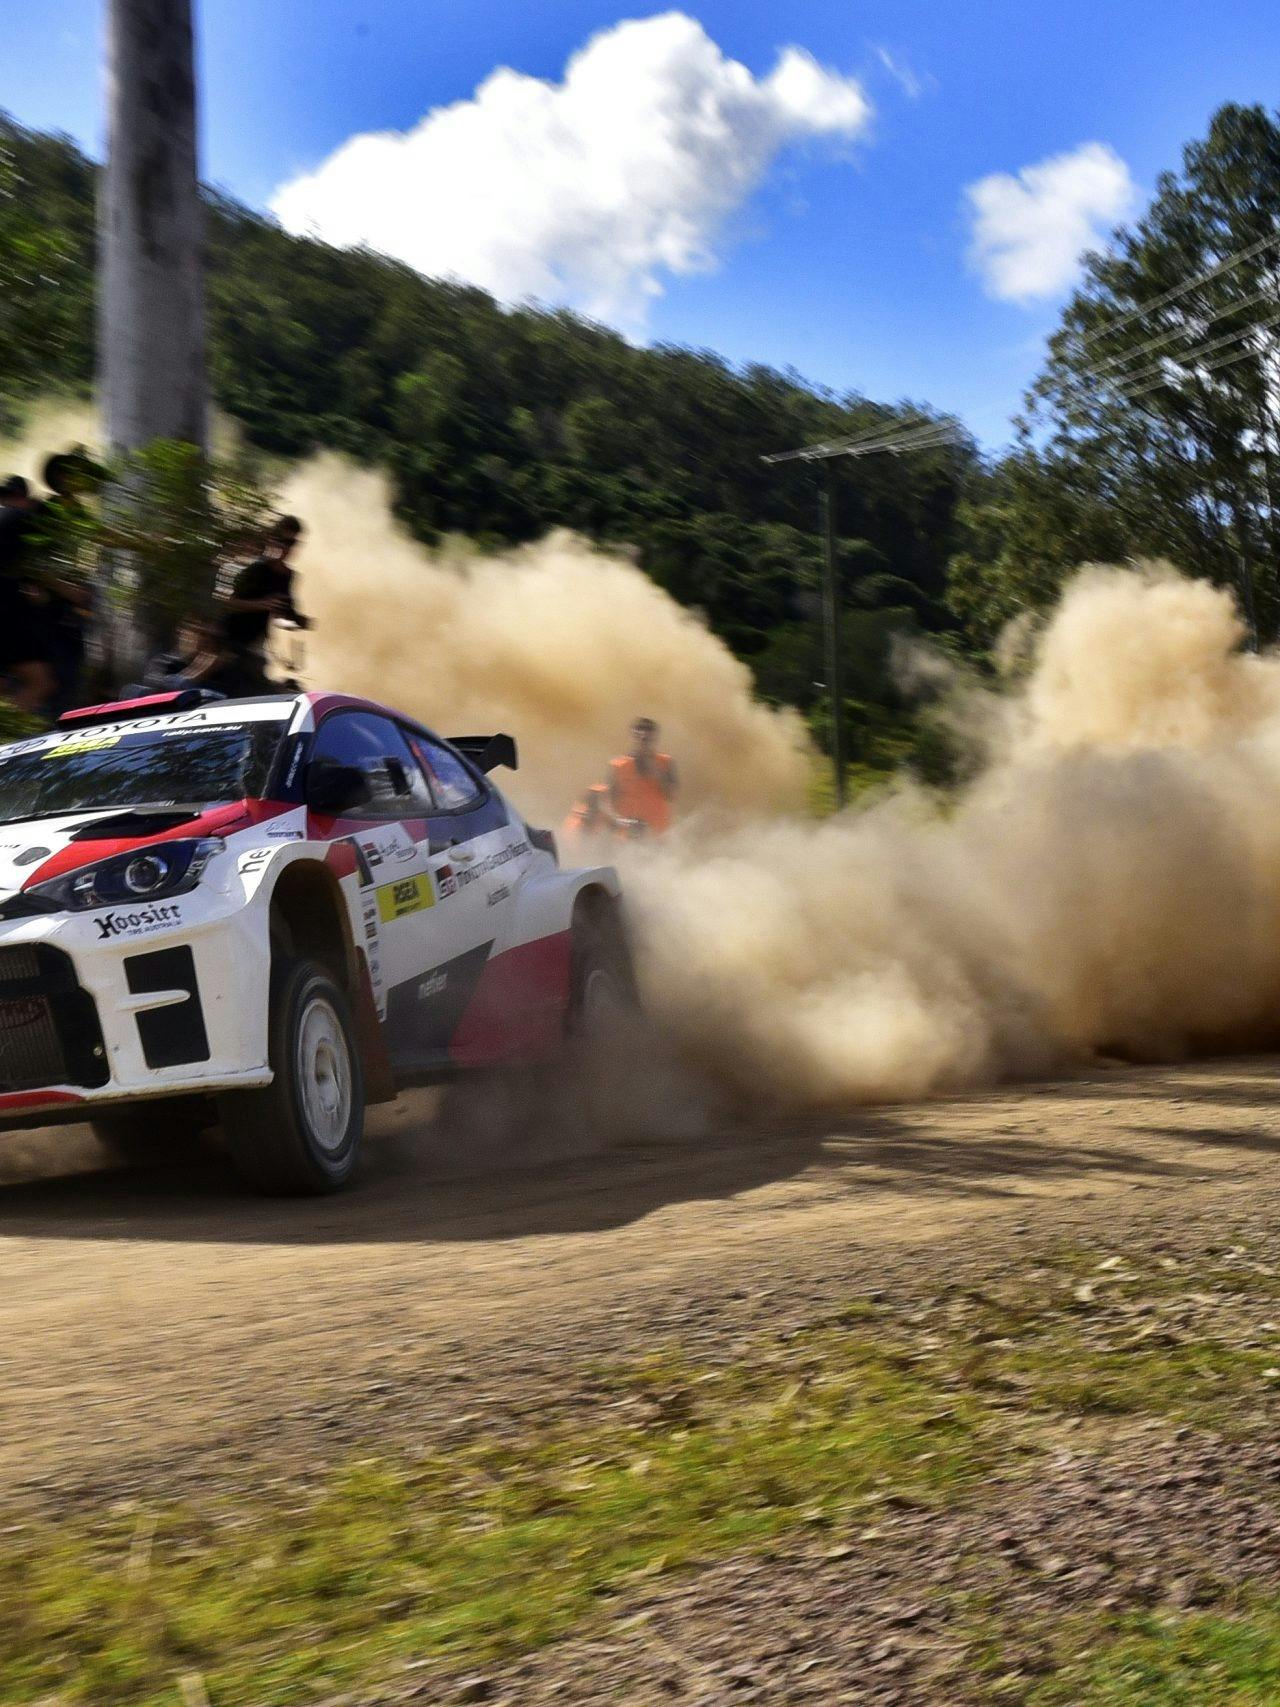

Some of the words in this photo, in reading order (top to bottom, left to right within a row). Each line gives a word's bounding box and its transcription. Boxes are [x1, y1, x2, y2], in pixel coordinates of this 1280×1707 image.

[61, 712, 207, 742] TOYOTA
[161, 724, 243, 737] rally.com.au
[92, 904, 182, 940] Hoosier
